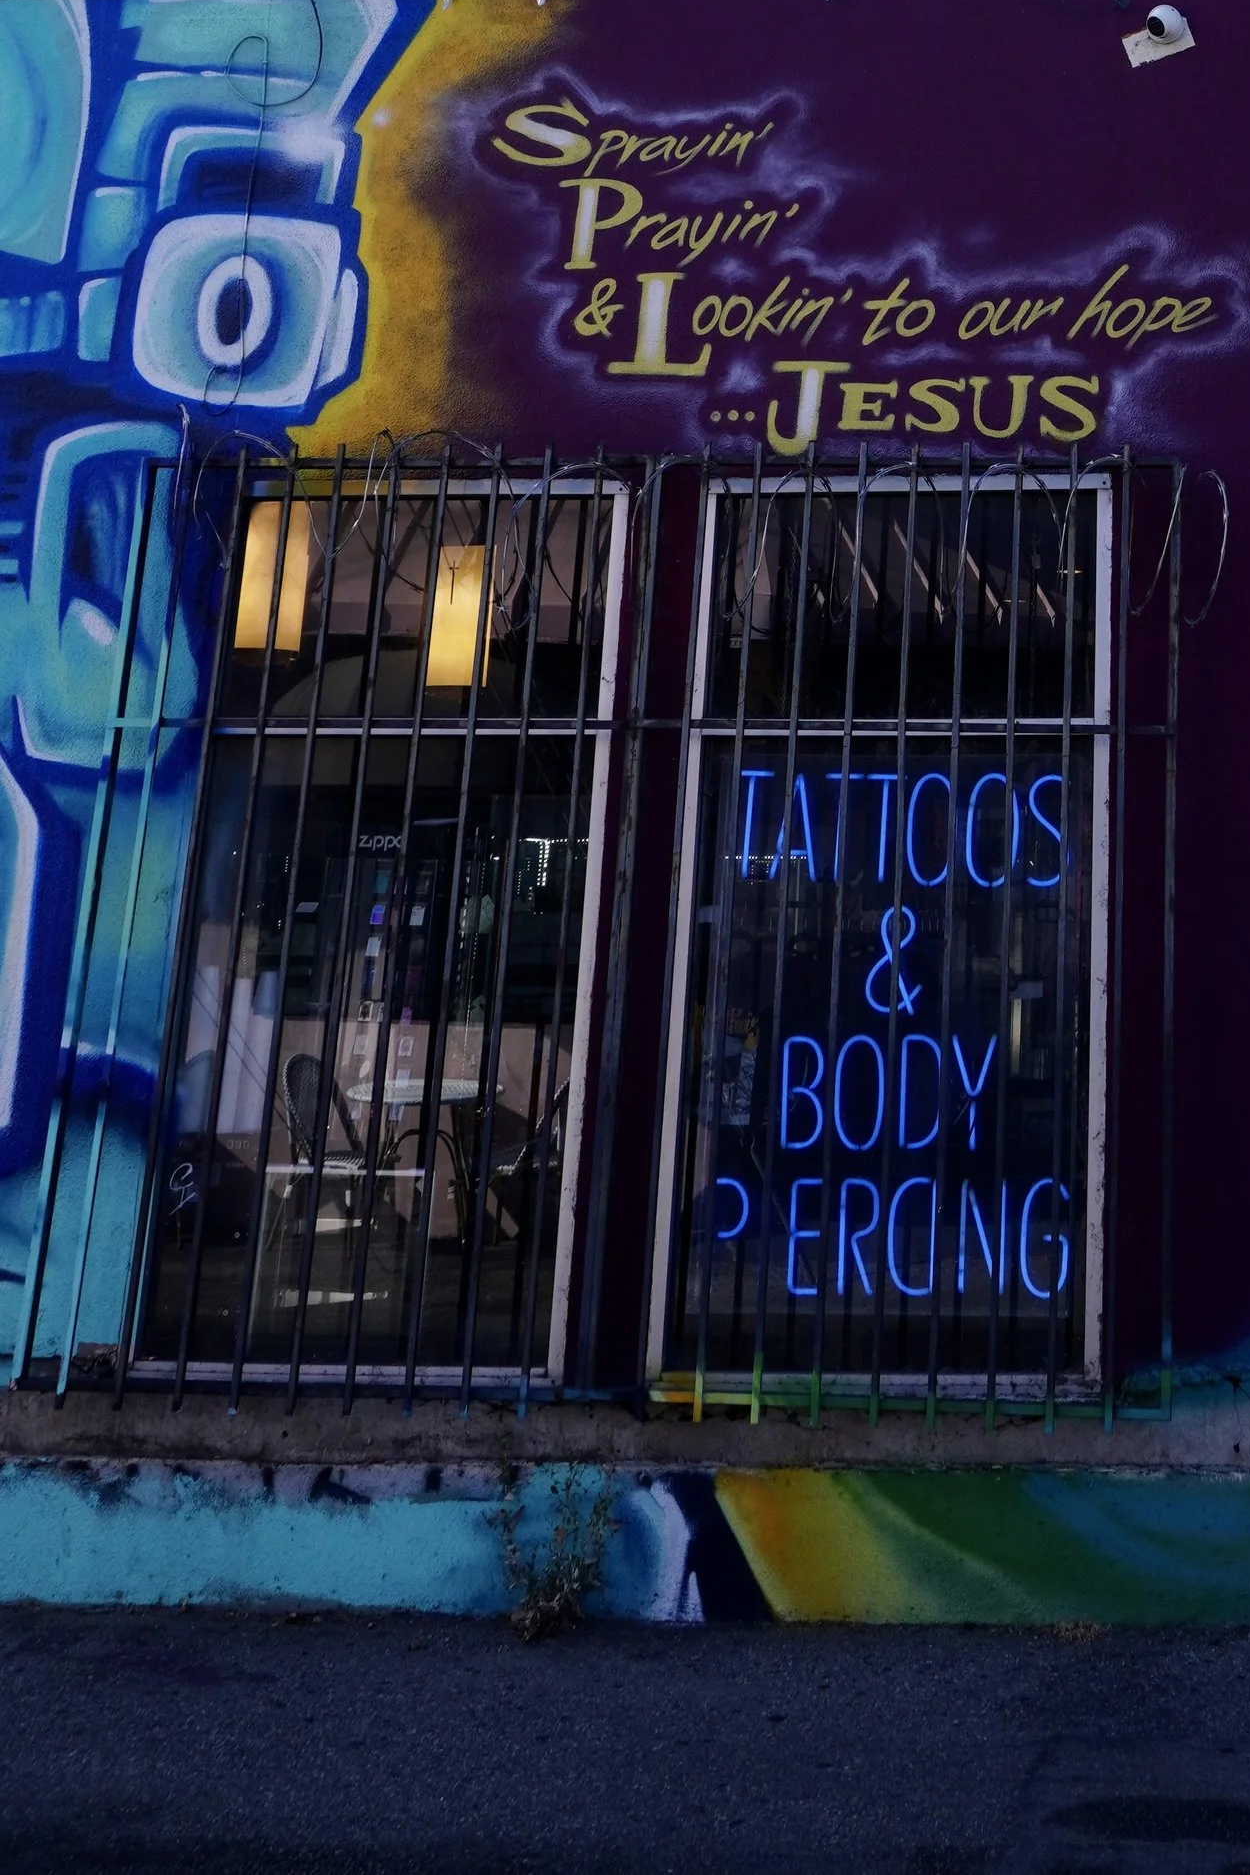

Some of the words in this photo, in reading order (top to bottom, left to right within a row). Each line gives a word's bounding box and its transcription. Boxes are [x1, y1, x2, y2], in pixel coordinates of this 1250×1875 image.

[492, 98, 774, 175] Sprayin'
[559, 178, 800, 271] Prayin'
[573, 277, 623, 337] &
[607, 271, 853, 378] Lookin'
[863, 277, 936, 345] to
[960, 293, 1061, 341] our
[1064, 265, 1221, 351] hope
[741, 769, 1071, 888] TATTOOS
[865, 905, 923, 1016] &
[780, 1033, 998, 1151] BODY
[716, 1176, 1071, 1300] PERCING
